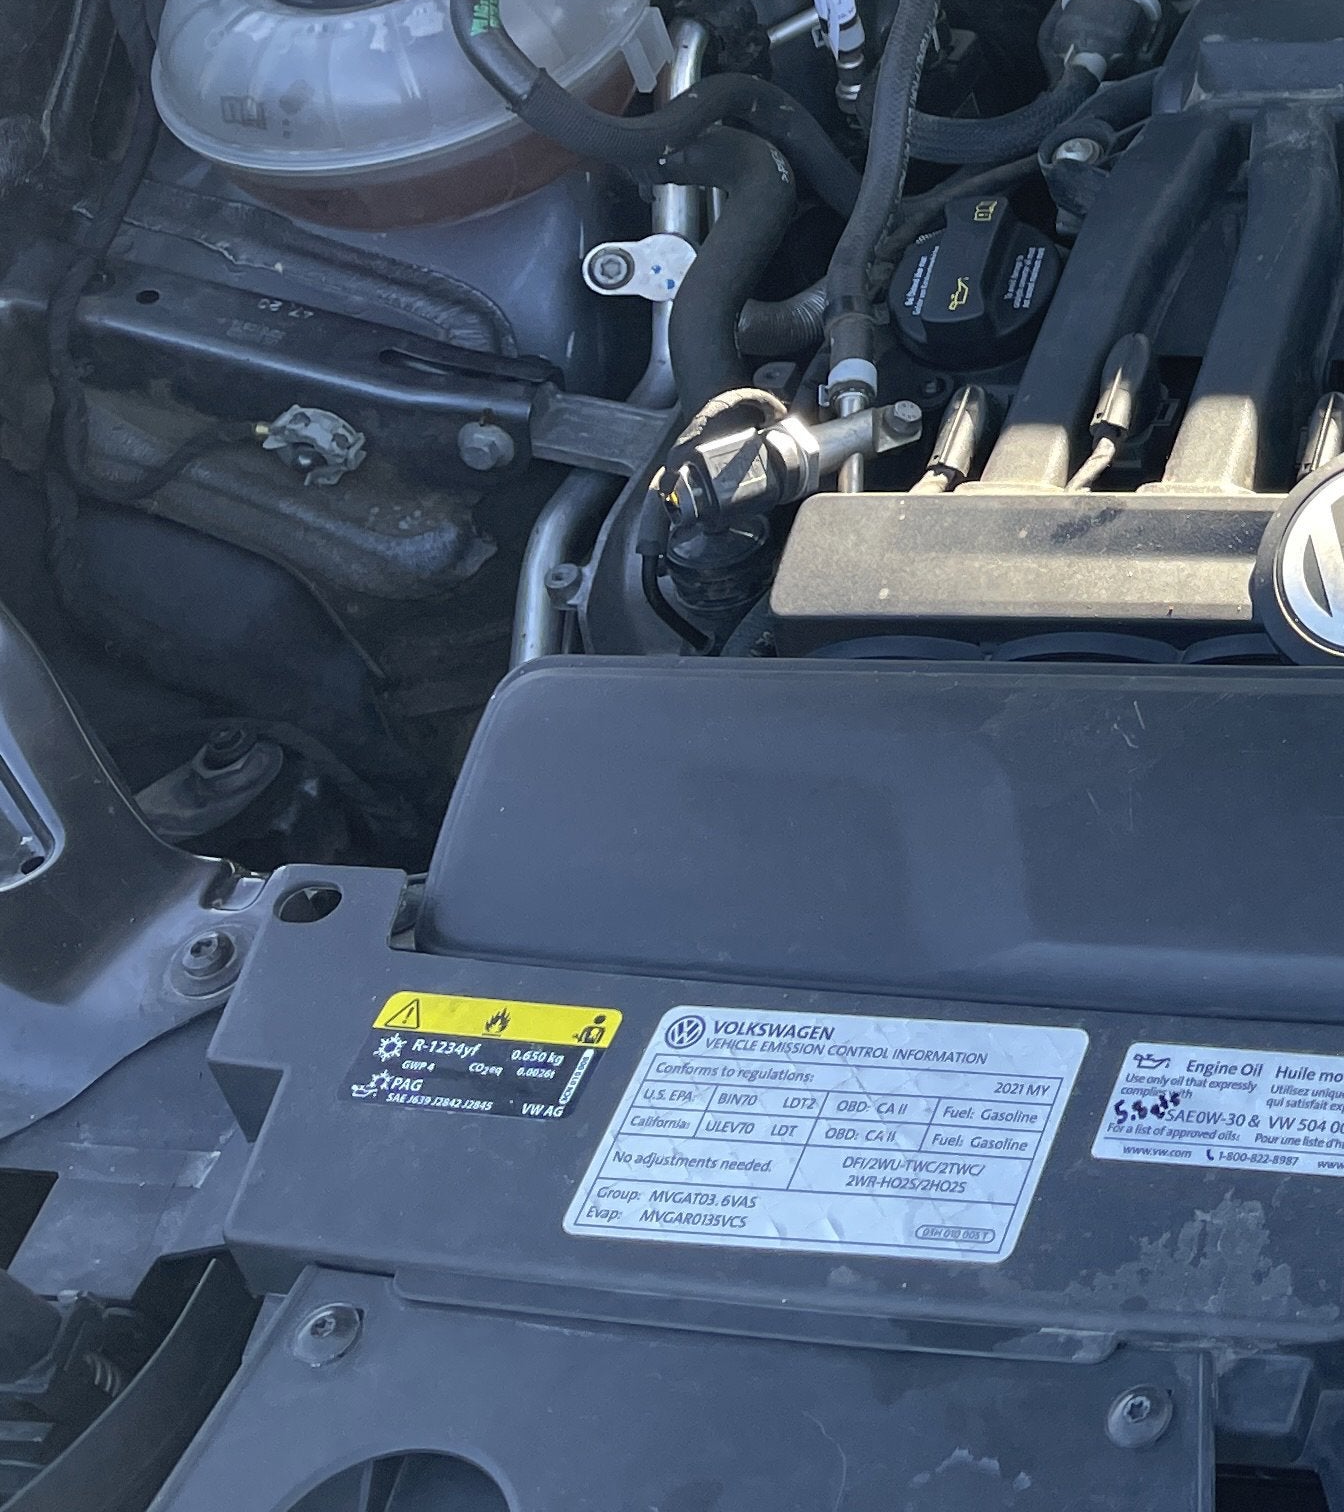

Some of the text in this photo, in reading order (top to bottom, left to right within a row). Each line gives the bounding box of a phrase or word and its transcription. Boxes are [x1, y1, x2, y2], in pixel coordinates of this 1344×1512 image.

[713, 1020, 835, 1040] VOLKSWAGEN
[411, 1038, 481, 1058] R-1234yf
[705, 1037, 988, 1064] VEHICLE EMISSION CONTROL INFORMATION
[401, 1059, 427, 1070] GWP
[510, 1048, 564, 1066] 0.650 kg
[655, 1061, 814, 1084] Conforms to regulations:
[1185, 1059, 1237, 1077] Engine
[1240, 1063, 1263, 1076] Oil
[1274, 1065, 1316, 1080] Huile
[389, 1076, 423, 1091] PAG
[993, 1081, 1050, 1096] 2021 MY
[1124, 1072, 1257, 1093] Use only oil that expressly
[385, 1092, 407, 1103] SAE
[642, 1087, 666, 1101] U.S.
[717, 1092, 758, 1105] BIN70
[521, 1102, 565, 1117] VW AG
[782, 1096, 816, 1109] LDT2
[836, 1099, 871, 1112] OBD:
[874, 1102, 894, 1114] CA
[942, 1105, 1037, 1123] Fuel: Gasoline
[704, 1119, 755, 1134] ULEV70
[770, 1123, 798, 1137] LDT
[1247, 1114, 1260, 1128] &
[1268, 1115, 1296, 1130] VW
[1296, 1118, 1326, 1132] 504
[824, 1126, 859, 1140] OBD:
[864, 1129, 887, 1142] CA
[931, 1133, 1028, 1151] Fuel: Gasoline
[1122, 1145, 1192, 1158] www.vw.com
[1218, 1150, 1299, 1166] 1-800-822-8987
[612, 1149, 772, 1172] No adjustments needed.
[596, 1185, 641, 1203] Group:
[585, 1205, 622, 1222] Evap:
